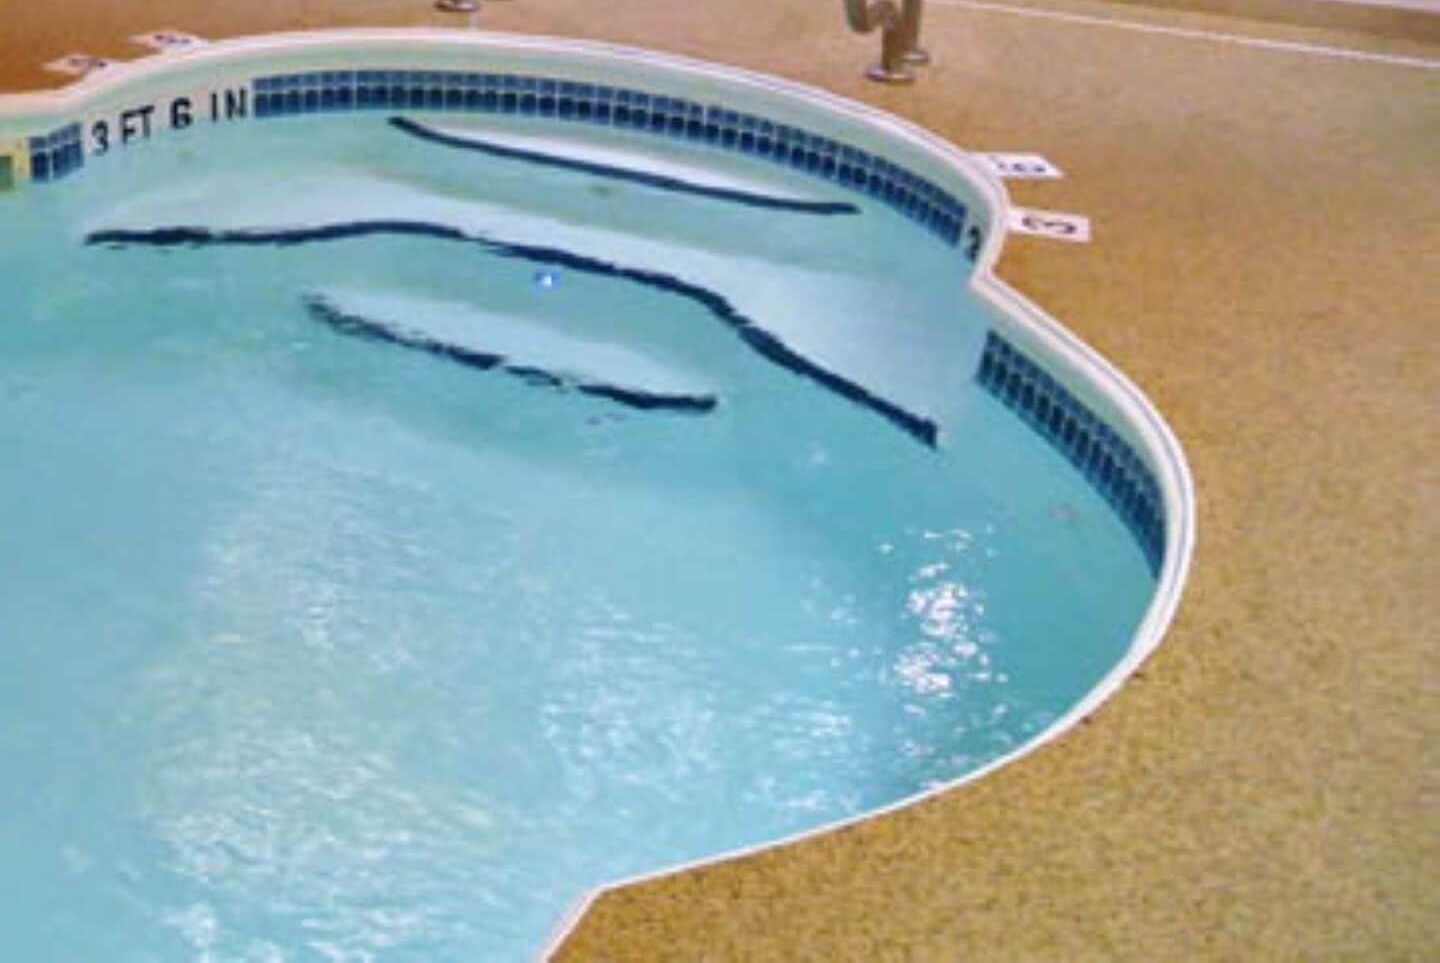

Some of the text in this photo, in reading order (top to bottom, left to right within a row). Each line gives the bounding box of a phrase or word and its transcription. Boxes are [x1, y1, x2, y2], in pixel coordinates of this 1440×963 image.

[92, 120, 109, 156] 3
[120, 104, 155, 145] FT
[210, 87, 247, 122] IN
